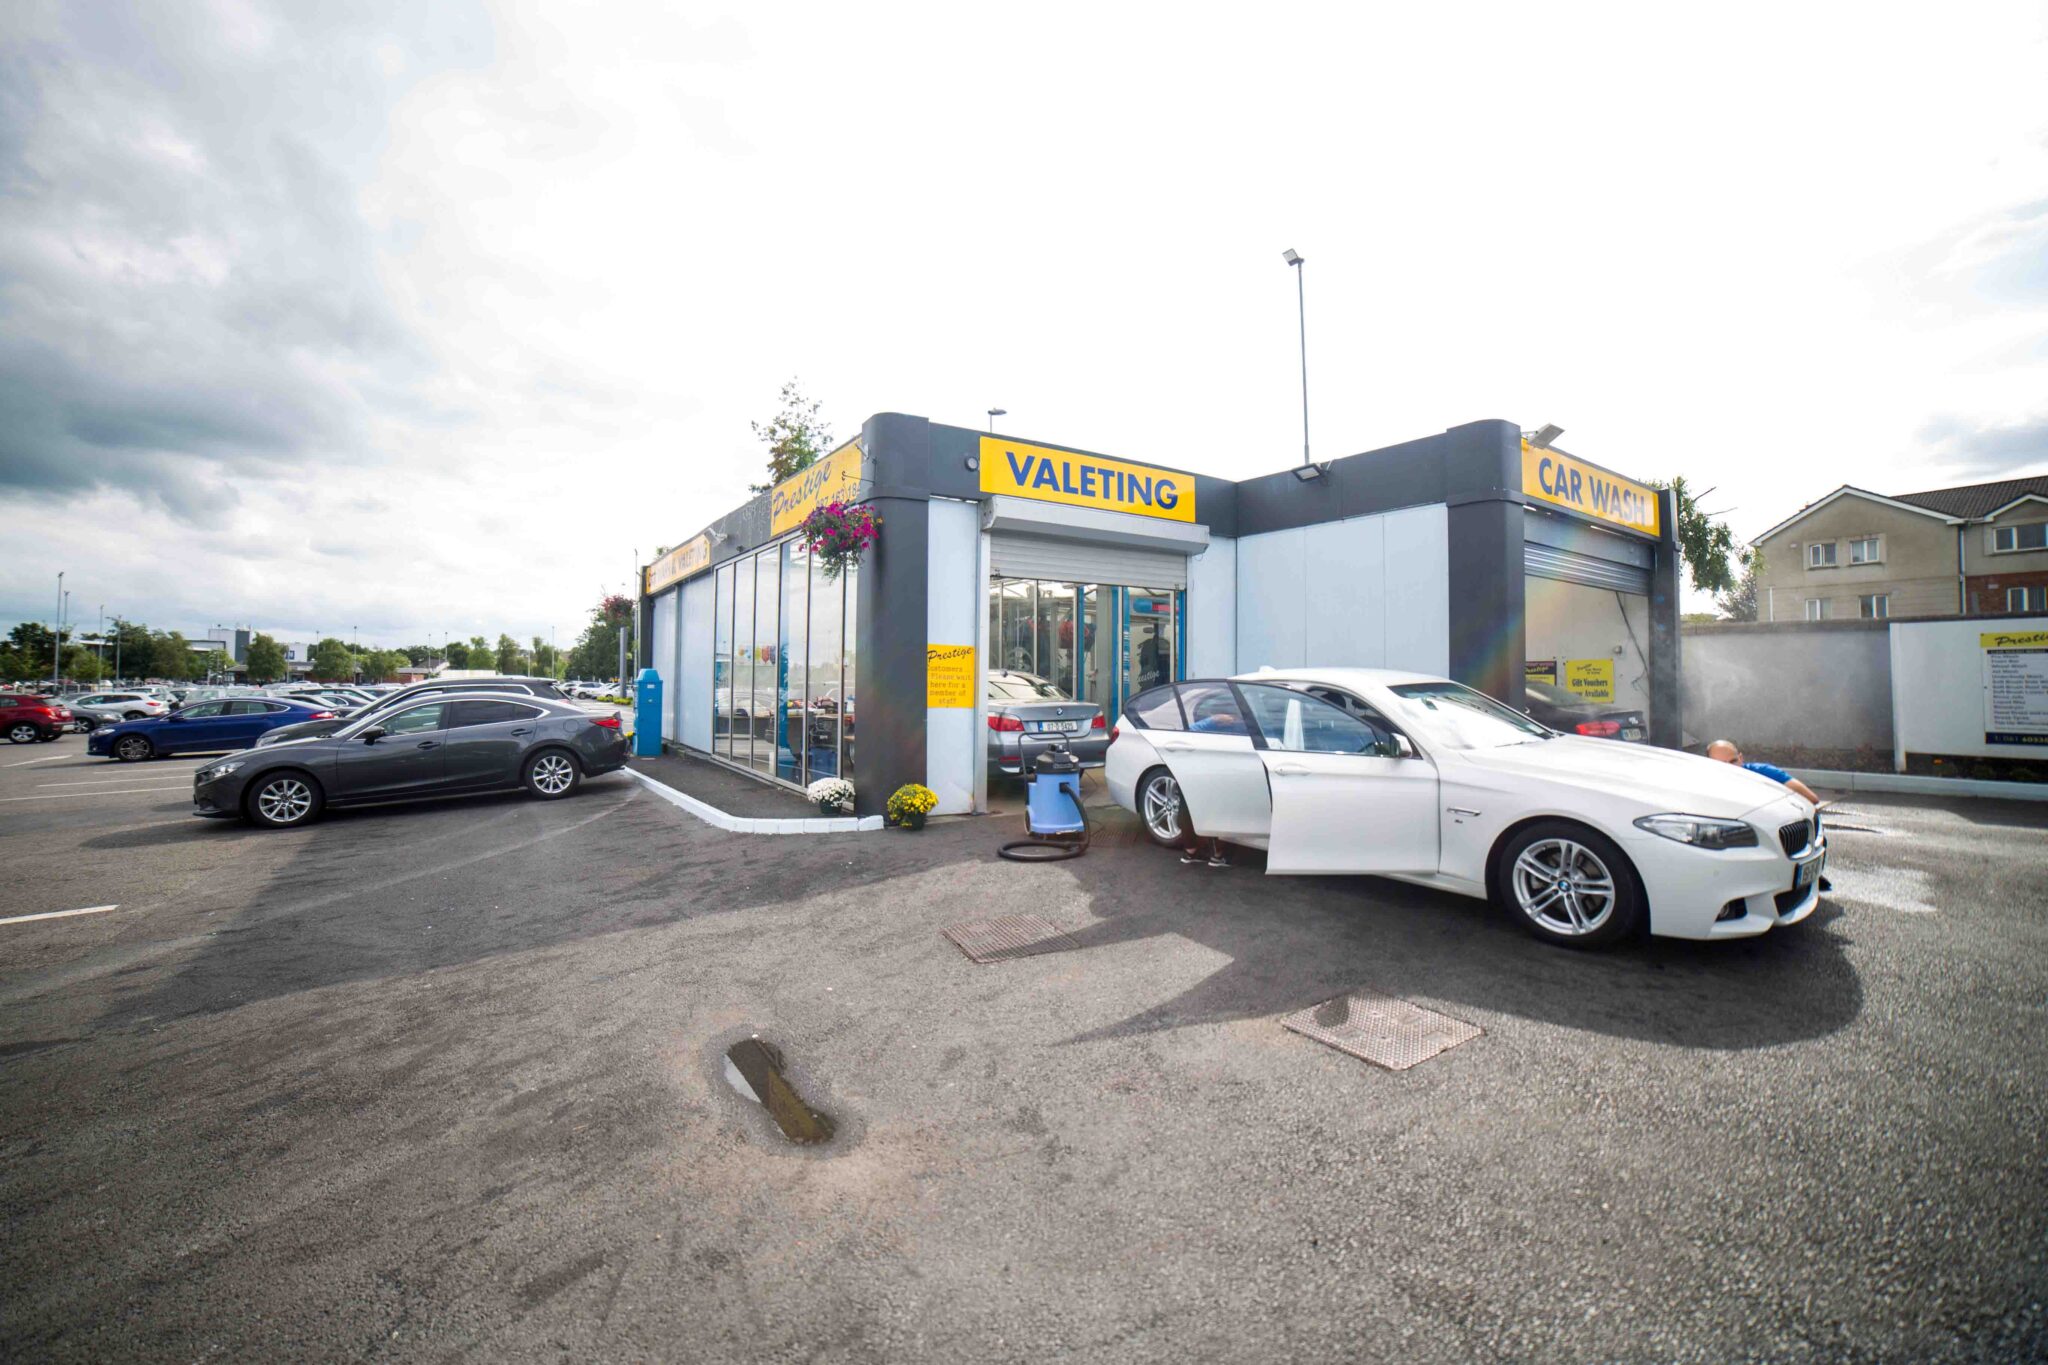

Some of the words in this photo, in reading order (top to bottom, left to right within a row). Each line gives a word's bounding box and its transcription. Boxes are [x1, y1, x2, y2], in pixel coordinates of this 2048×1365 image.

[773, 461, 832, 526] Prestige
[1005, 451, 1178, 510] VALETING
[1539, 457, 1583, 505] CAR
[1589, 475, 1645, 527] WASH
[927, 648, 973, 662] Prestige
[1572, 678, 1583, 687] Gift
[1583, 678, 1608, 687] Vouchers
